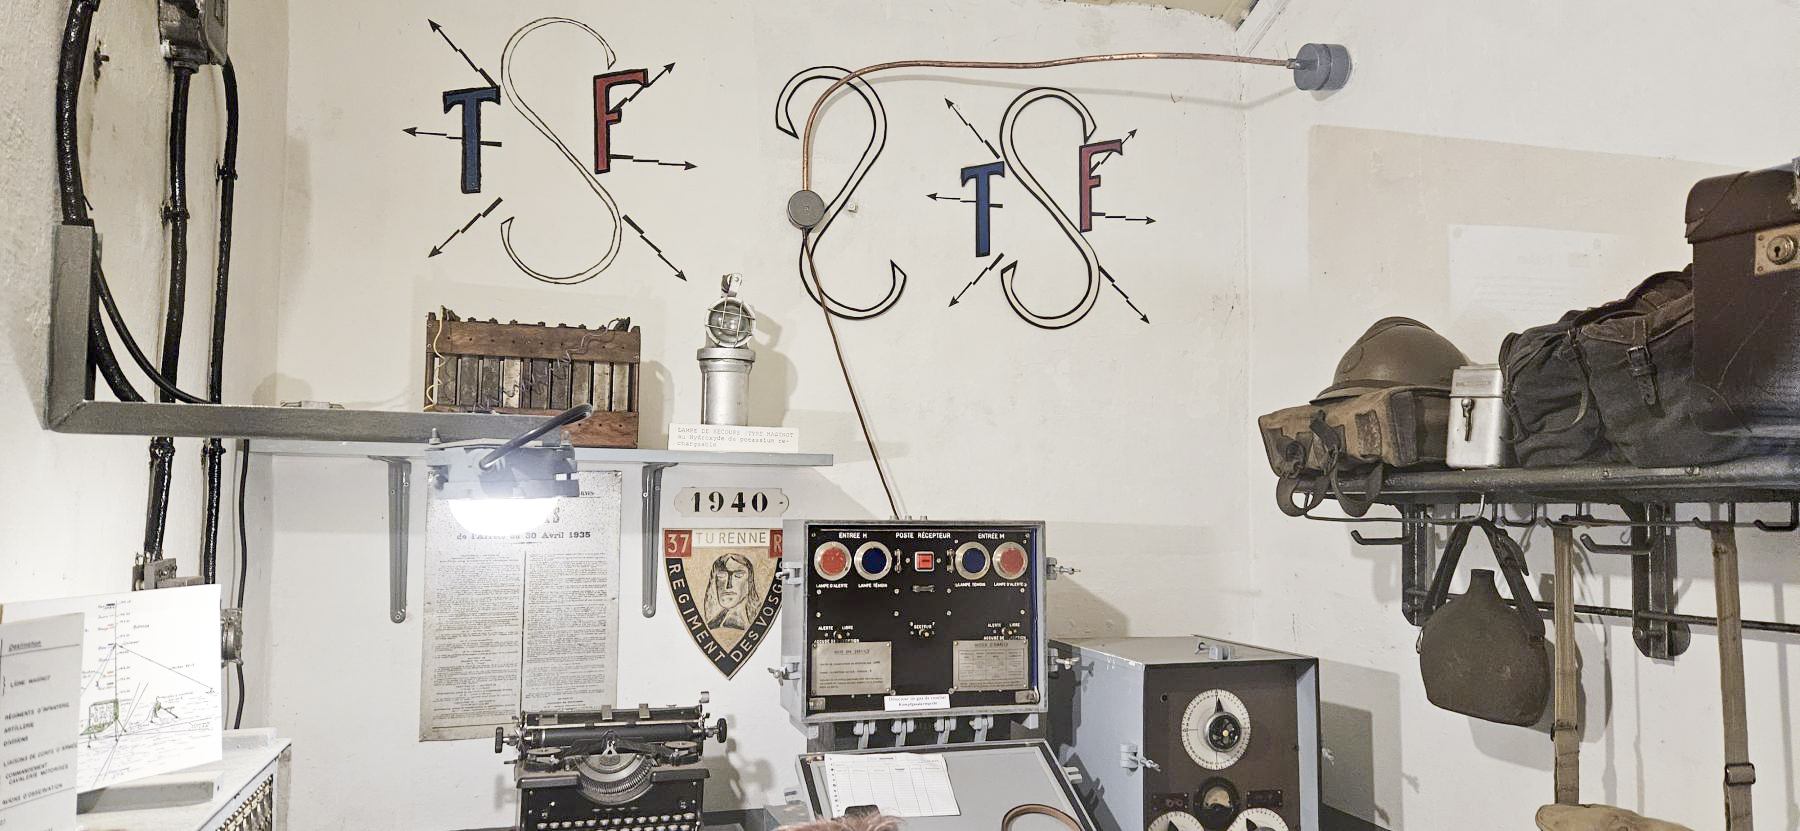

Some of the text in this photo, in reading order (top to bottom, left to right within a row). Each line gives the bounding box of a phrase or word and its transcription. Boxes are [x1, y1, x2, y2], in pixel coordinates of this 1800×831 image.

[691, 491, 768, 513] 1940
[569, 531, 591, 539] 1935
[668, 534, 690, 553] 37
[696, 532, 766, 544] TURENNE
[917, 531, 951, 539] RÉCEPTEUR
[668, 563, 725, 661] REGIMENT
[730, 632, 759, 662] DES
[4, 722, 34, 733] ARTILLERIE
